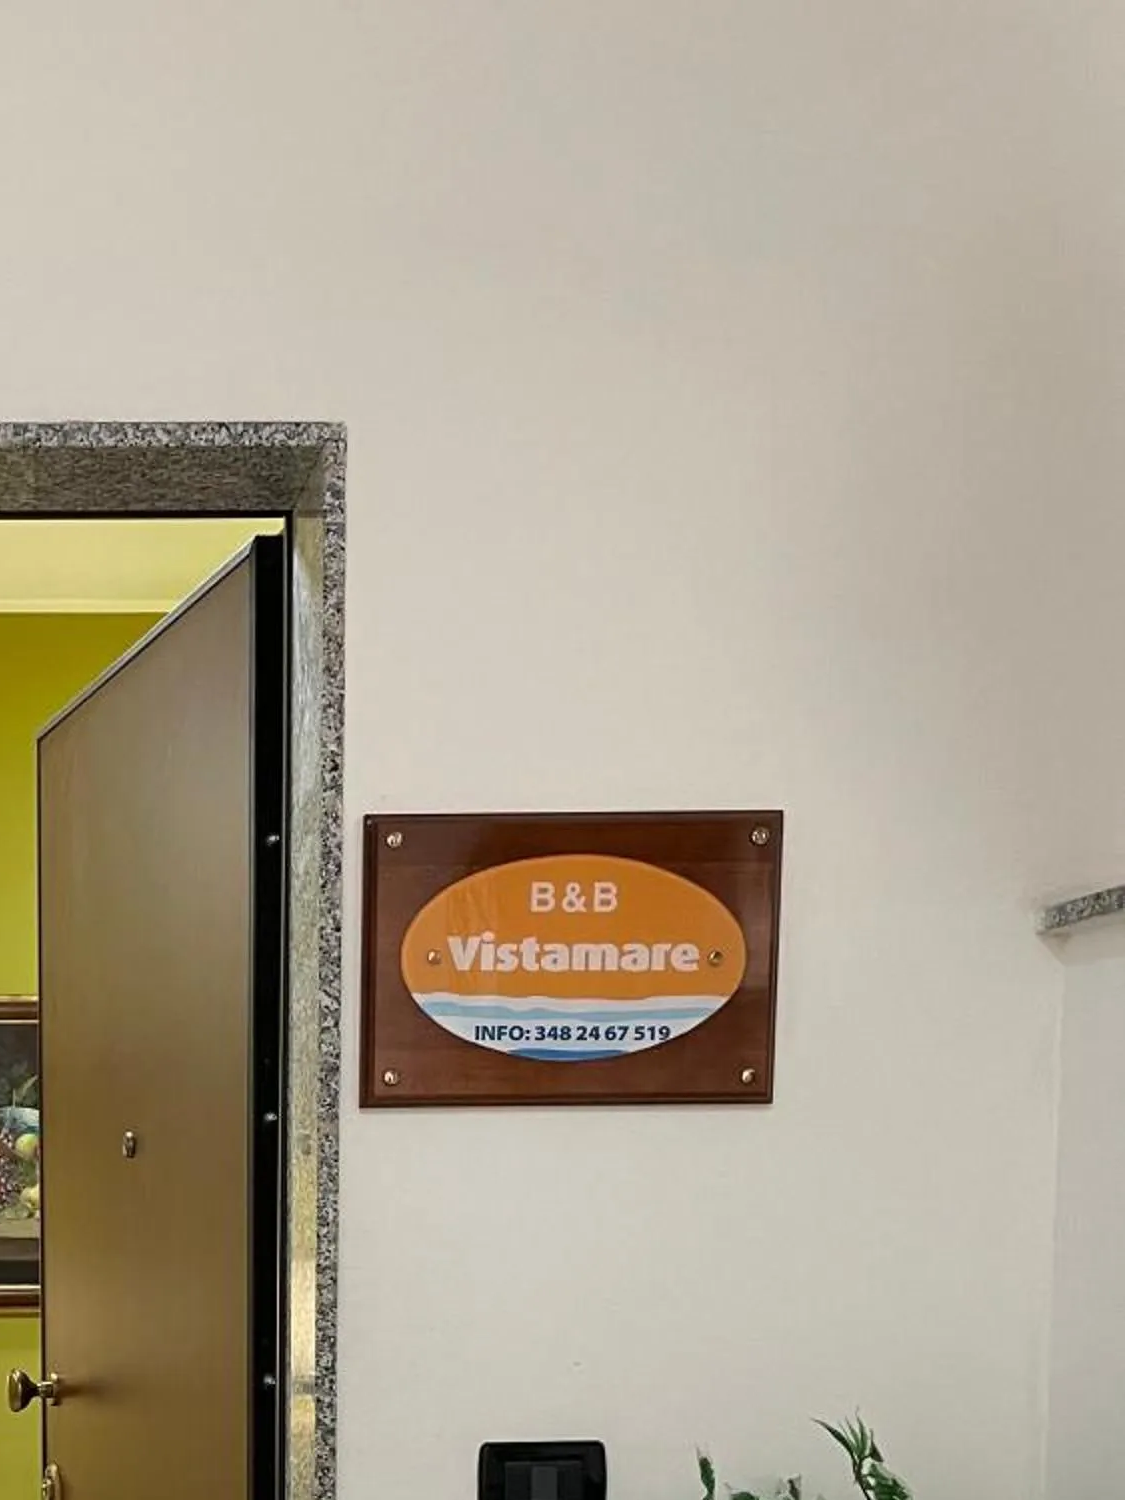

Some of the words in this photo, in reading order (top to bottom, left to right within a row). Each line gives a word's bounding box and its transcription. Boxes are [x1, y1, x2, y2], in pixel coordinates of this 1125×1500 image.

[447, 931, 700, 972] Vistamare
[475, 1026, 531, 1041] INFO:
[535, 1026, 572, 1041] 348
[634, 1026, 670, 1041] 519
